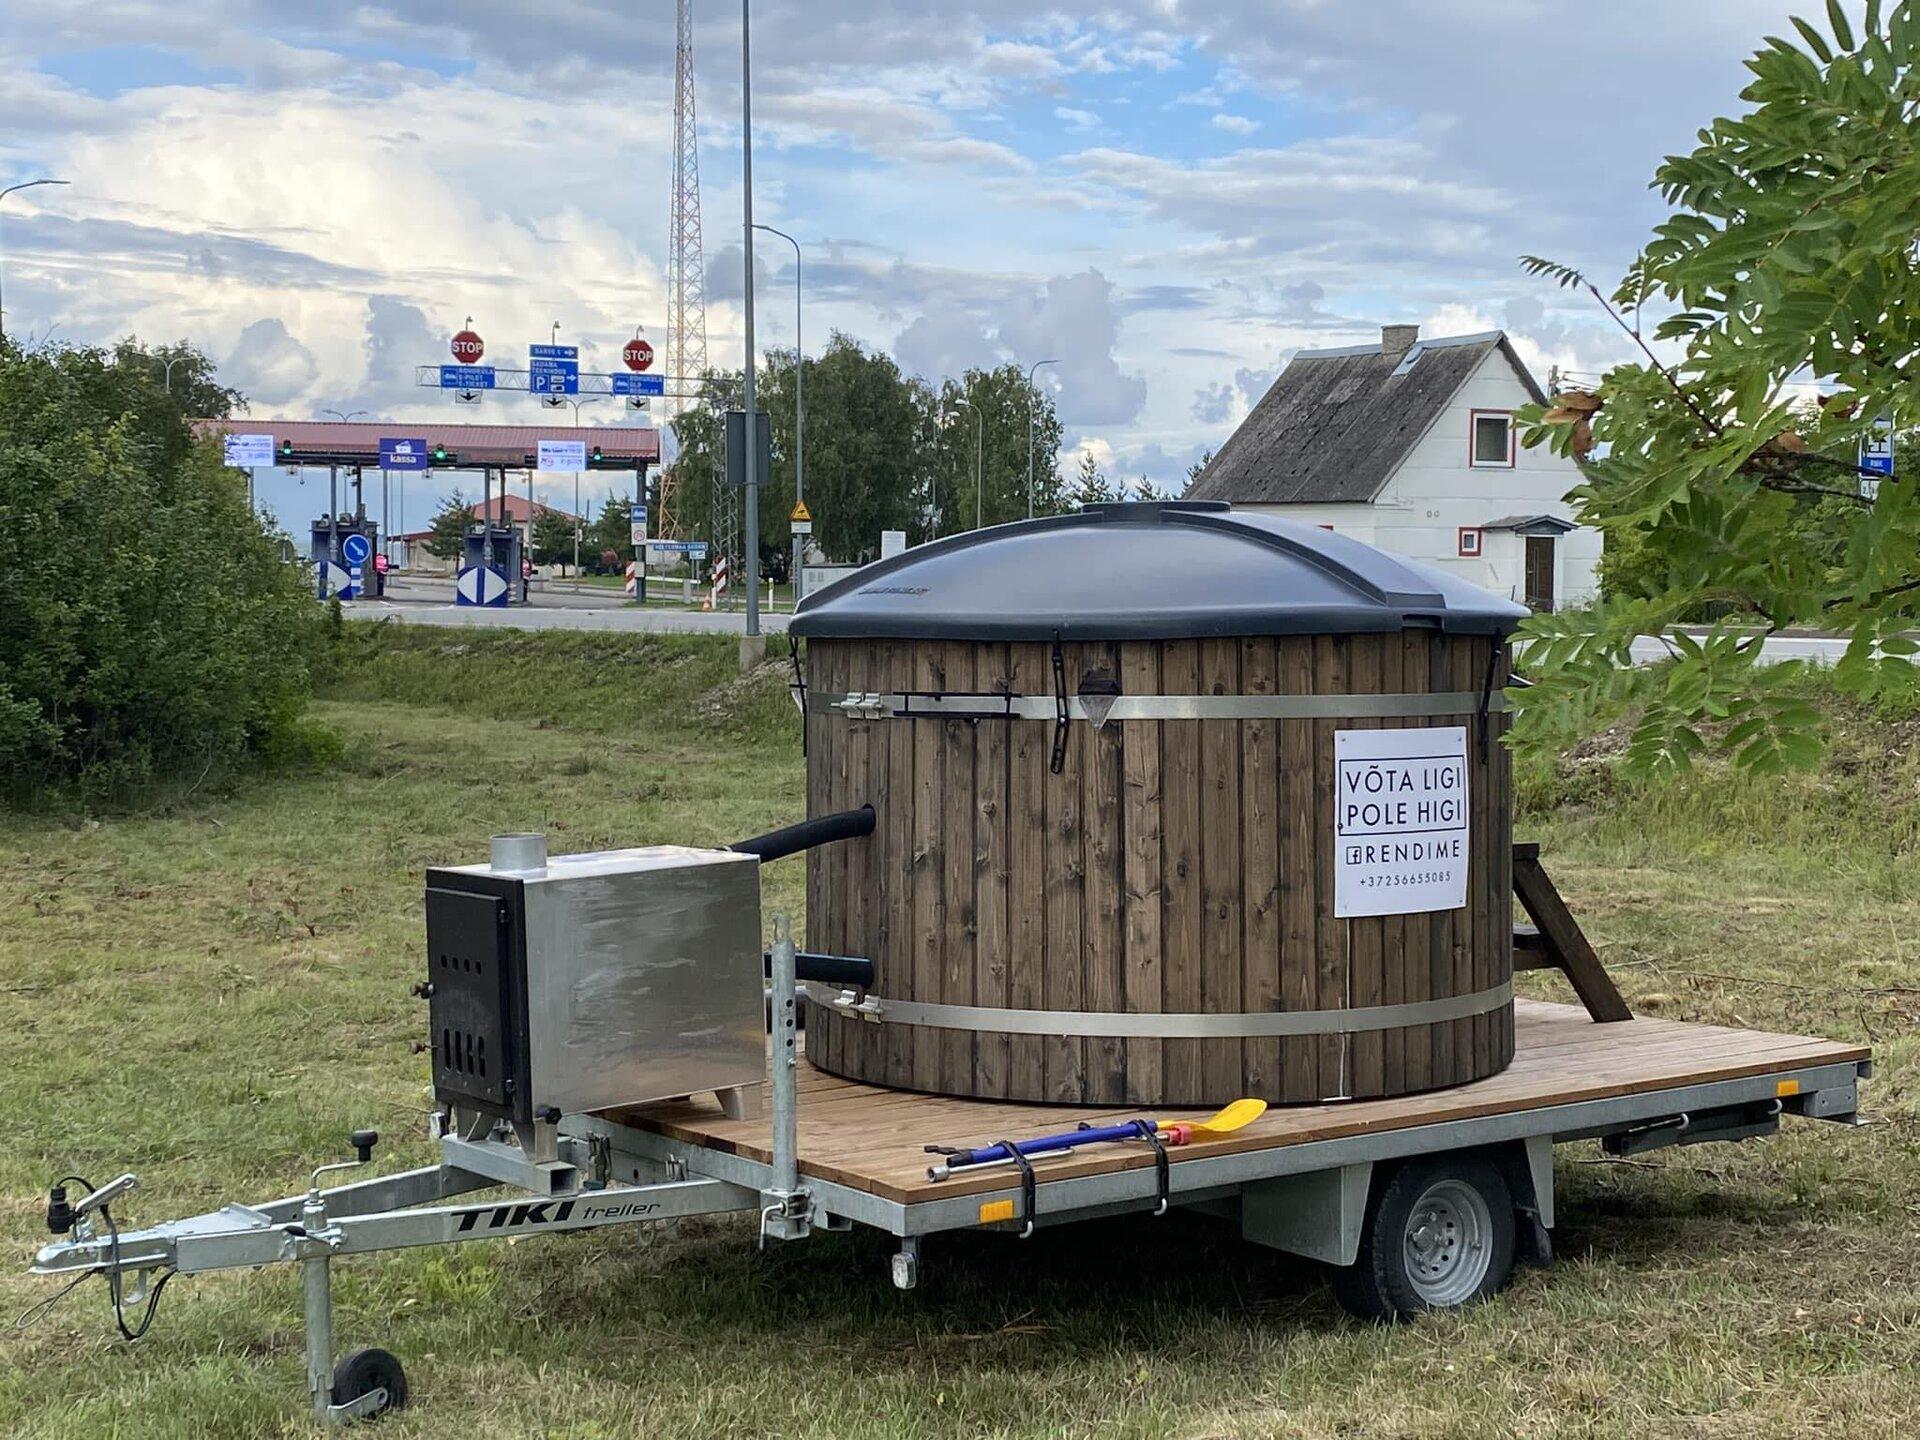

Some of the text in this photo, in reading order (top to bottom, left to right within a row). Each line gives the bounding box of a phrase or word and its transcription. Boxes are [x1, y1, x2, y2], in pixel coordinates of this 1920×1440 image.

[452, 341, 483, 354] STOP
[624, 350, 652, 362] STOP
[536, 376, 546, 391] P
[390, 454, 417, 464] kassa
[1346, 765, 1461, 793] VÕTA LIGI
[1347, 799, 1461, 827] POLE HIGI
[1366, 840, 1460, 863] RENDIME
[1360, 871, 1451, 887] +37256655085
[450, 1201, 576, 1232] TIKI
